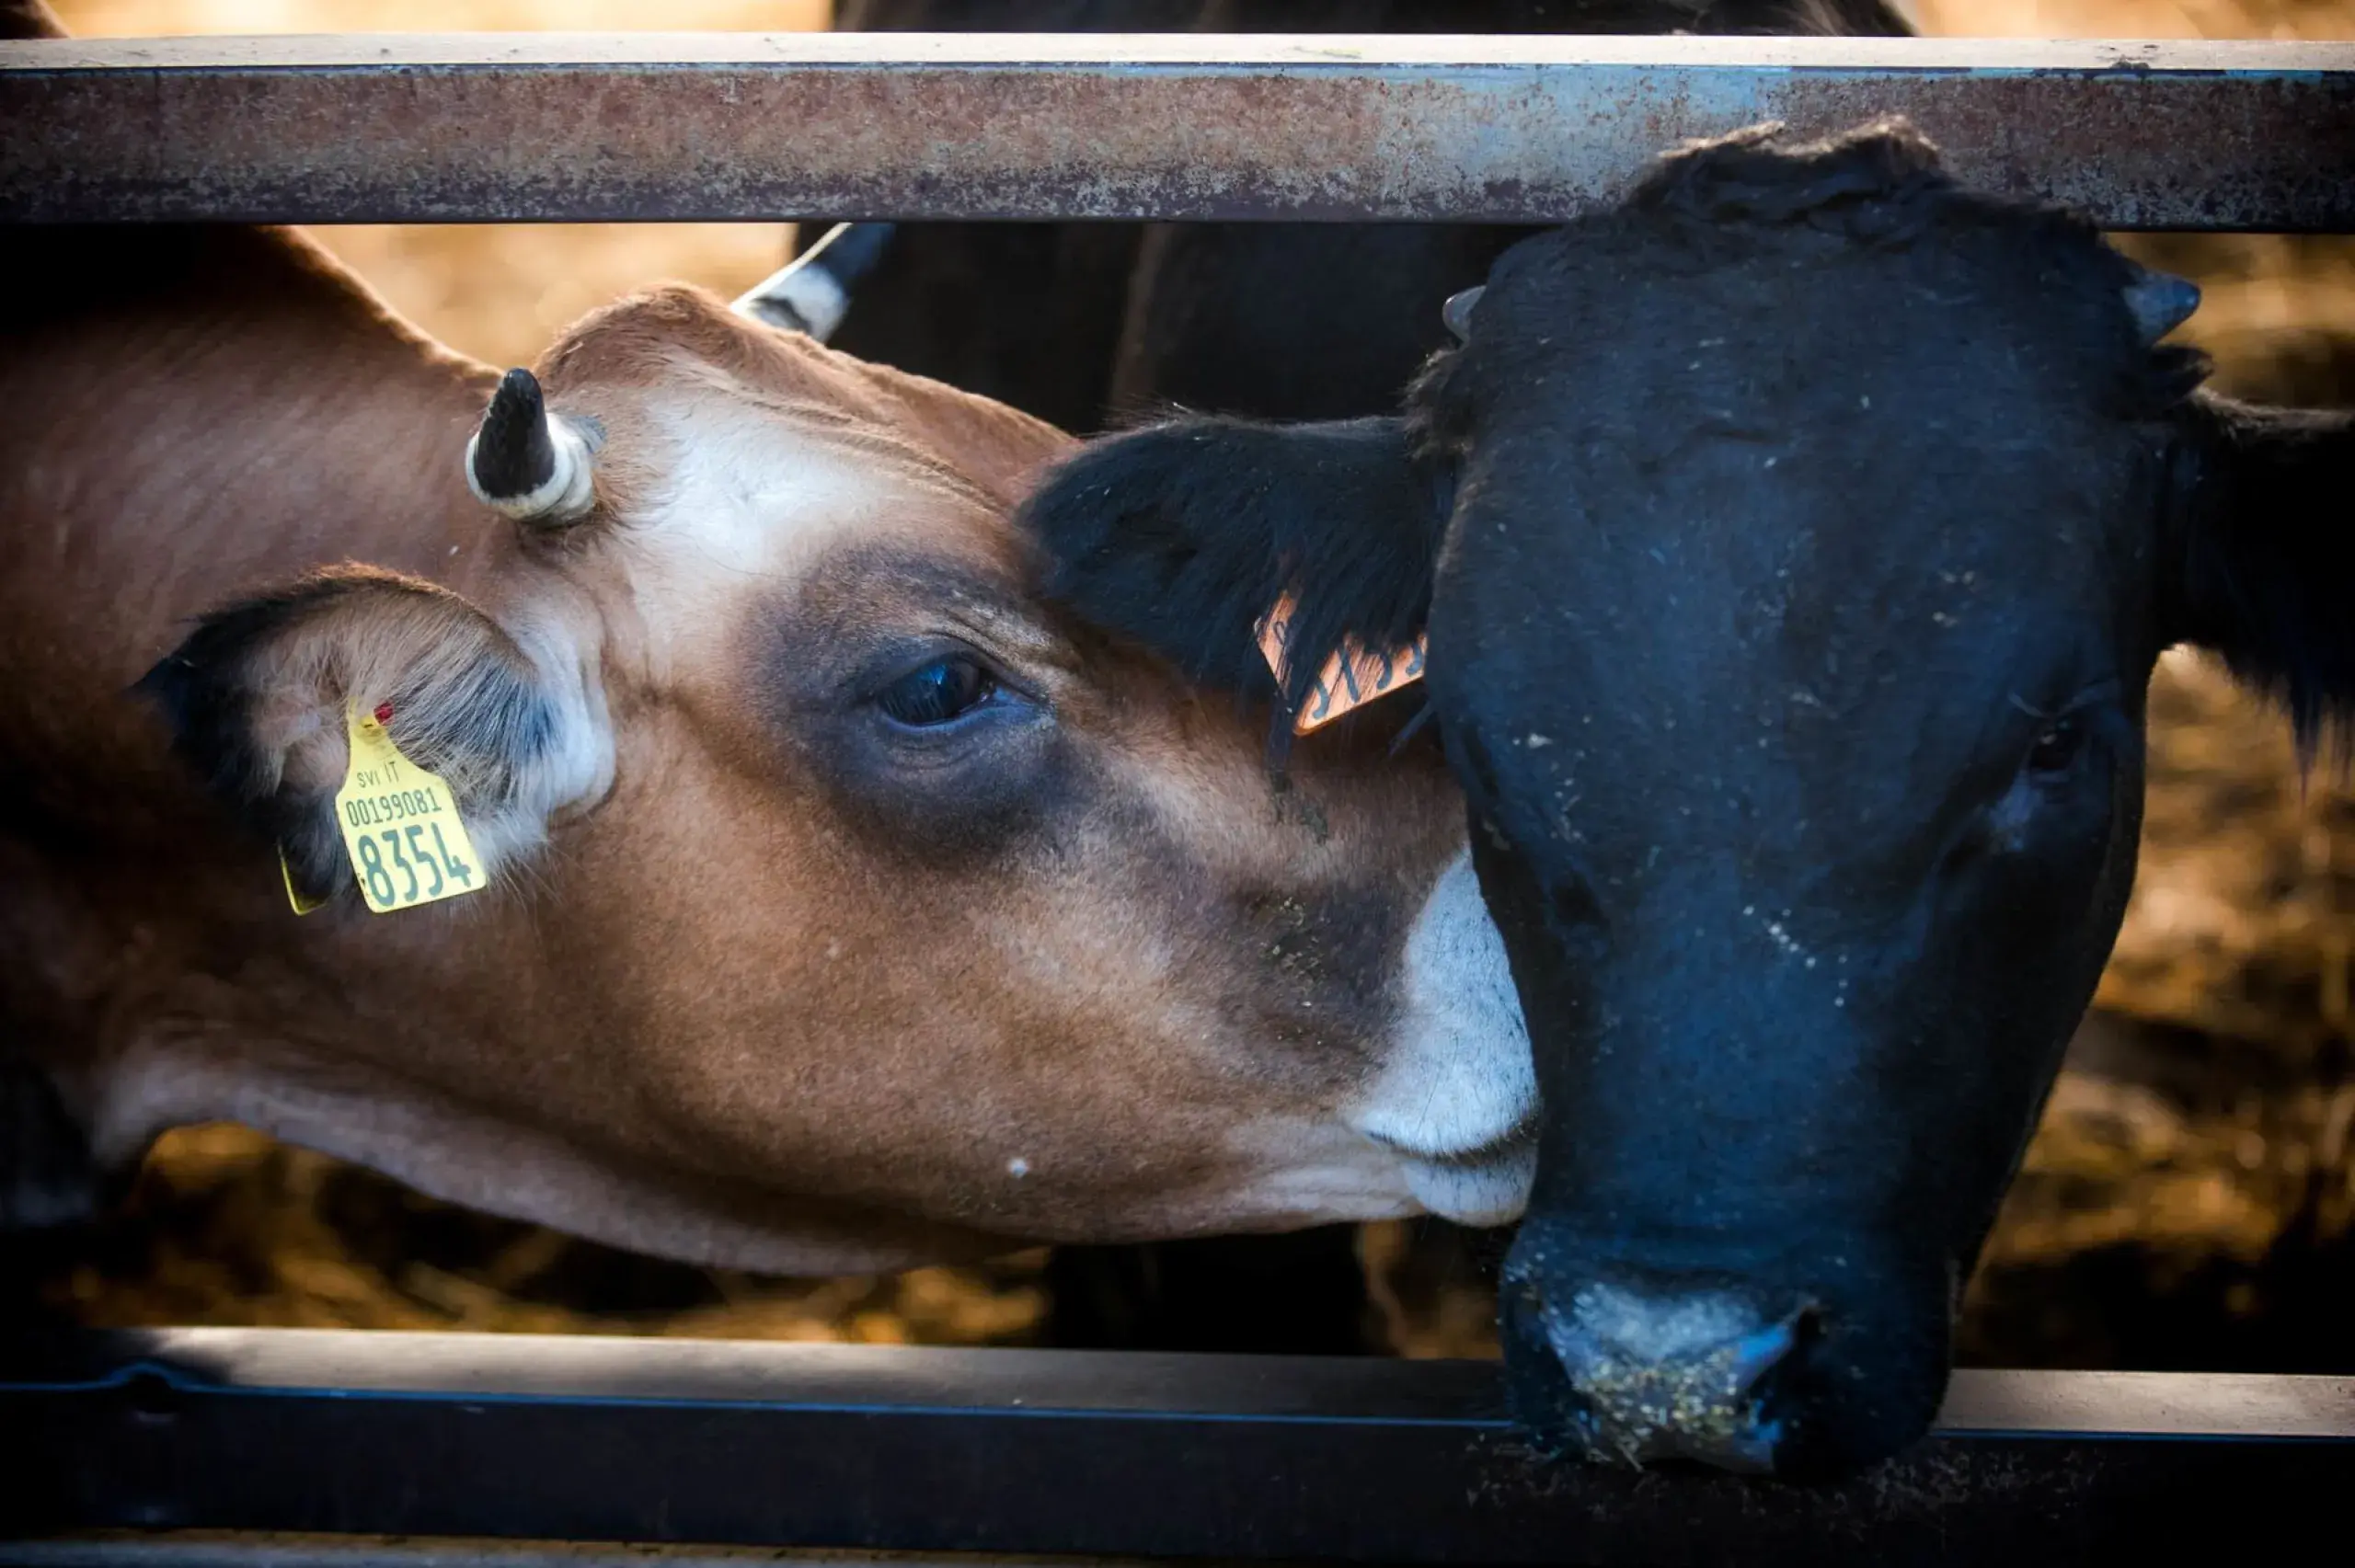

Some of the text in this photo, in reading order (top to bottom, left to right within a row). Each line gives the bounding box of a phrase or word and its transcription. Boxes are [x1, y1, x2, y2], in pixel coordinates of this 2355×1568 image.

[384, 761, 399, 784] IT
[346, 787, 442, 827] 00199081
[358, 822, 471, 907] 8354
